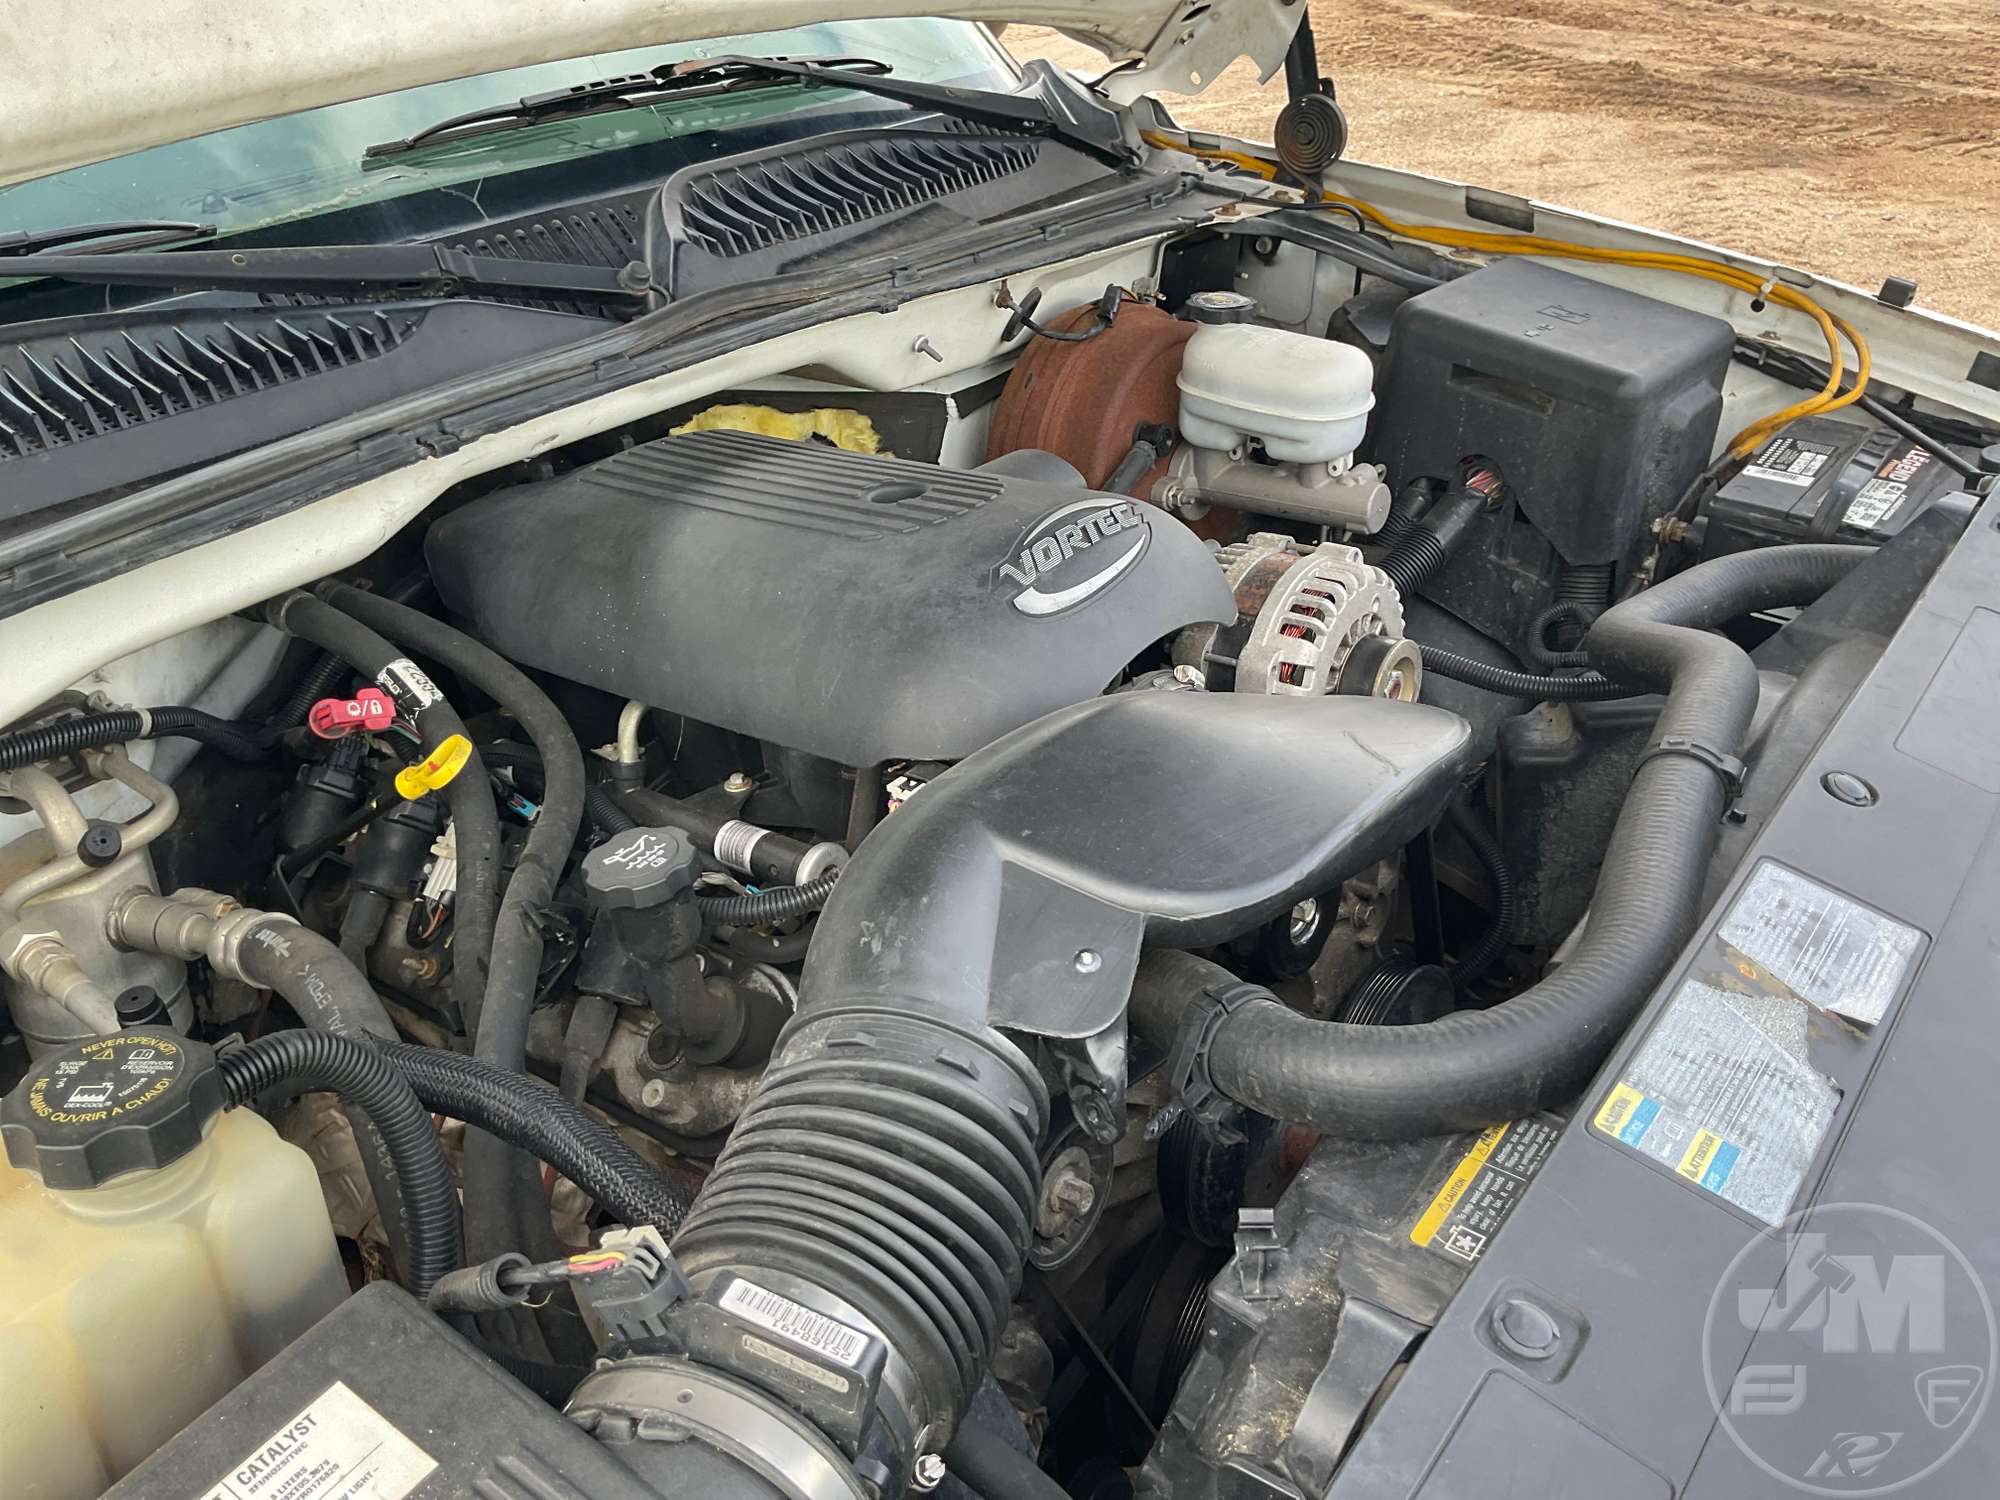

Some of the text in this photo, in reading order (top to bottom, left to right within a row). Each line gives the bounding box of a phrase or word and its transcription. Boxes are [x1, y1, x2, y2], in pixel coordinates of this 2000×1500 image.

[1000, 503, 1139, 585] VORTEC
[82, 1036, 125, 1054] NEVER
[127, 1034, 157, 1047] OPEN
[33, 1078, 50, 1091] NE
[50, 1110, 109, 1123] OUVRIR
[1445, 1177, 1466, 1203] CAUTION
[772, 1318, 852, 1361] 25168491
[236, 1413, 319, 1487] CATALYST
[277, 1466, 309, 1495] LITERS
[350, 1471, 374, 1495] LIGHT
